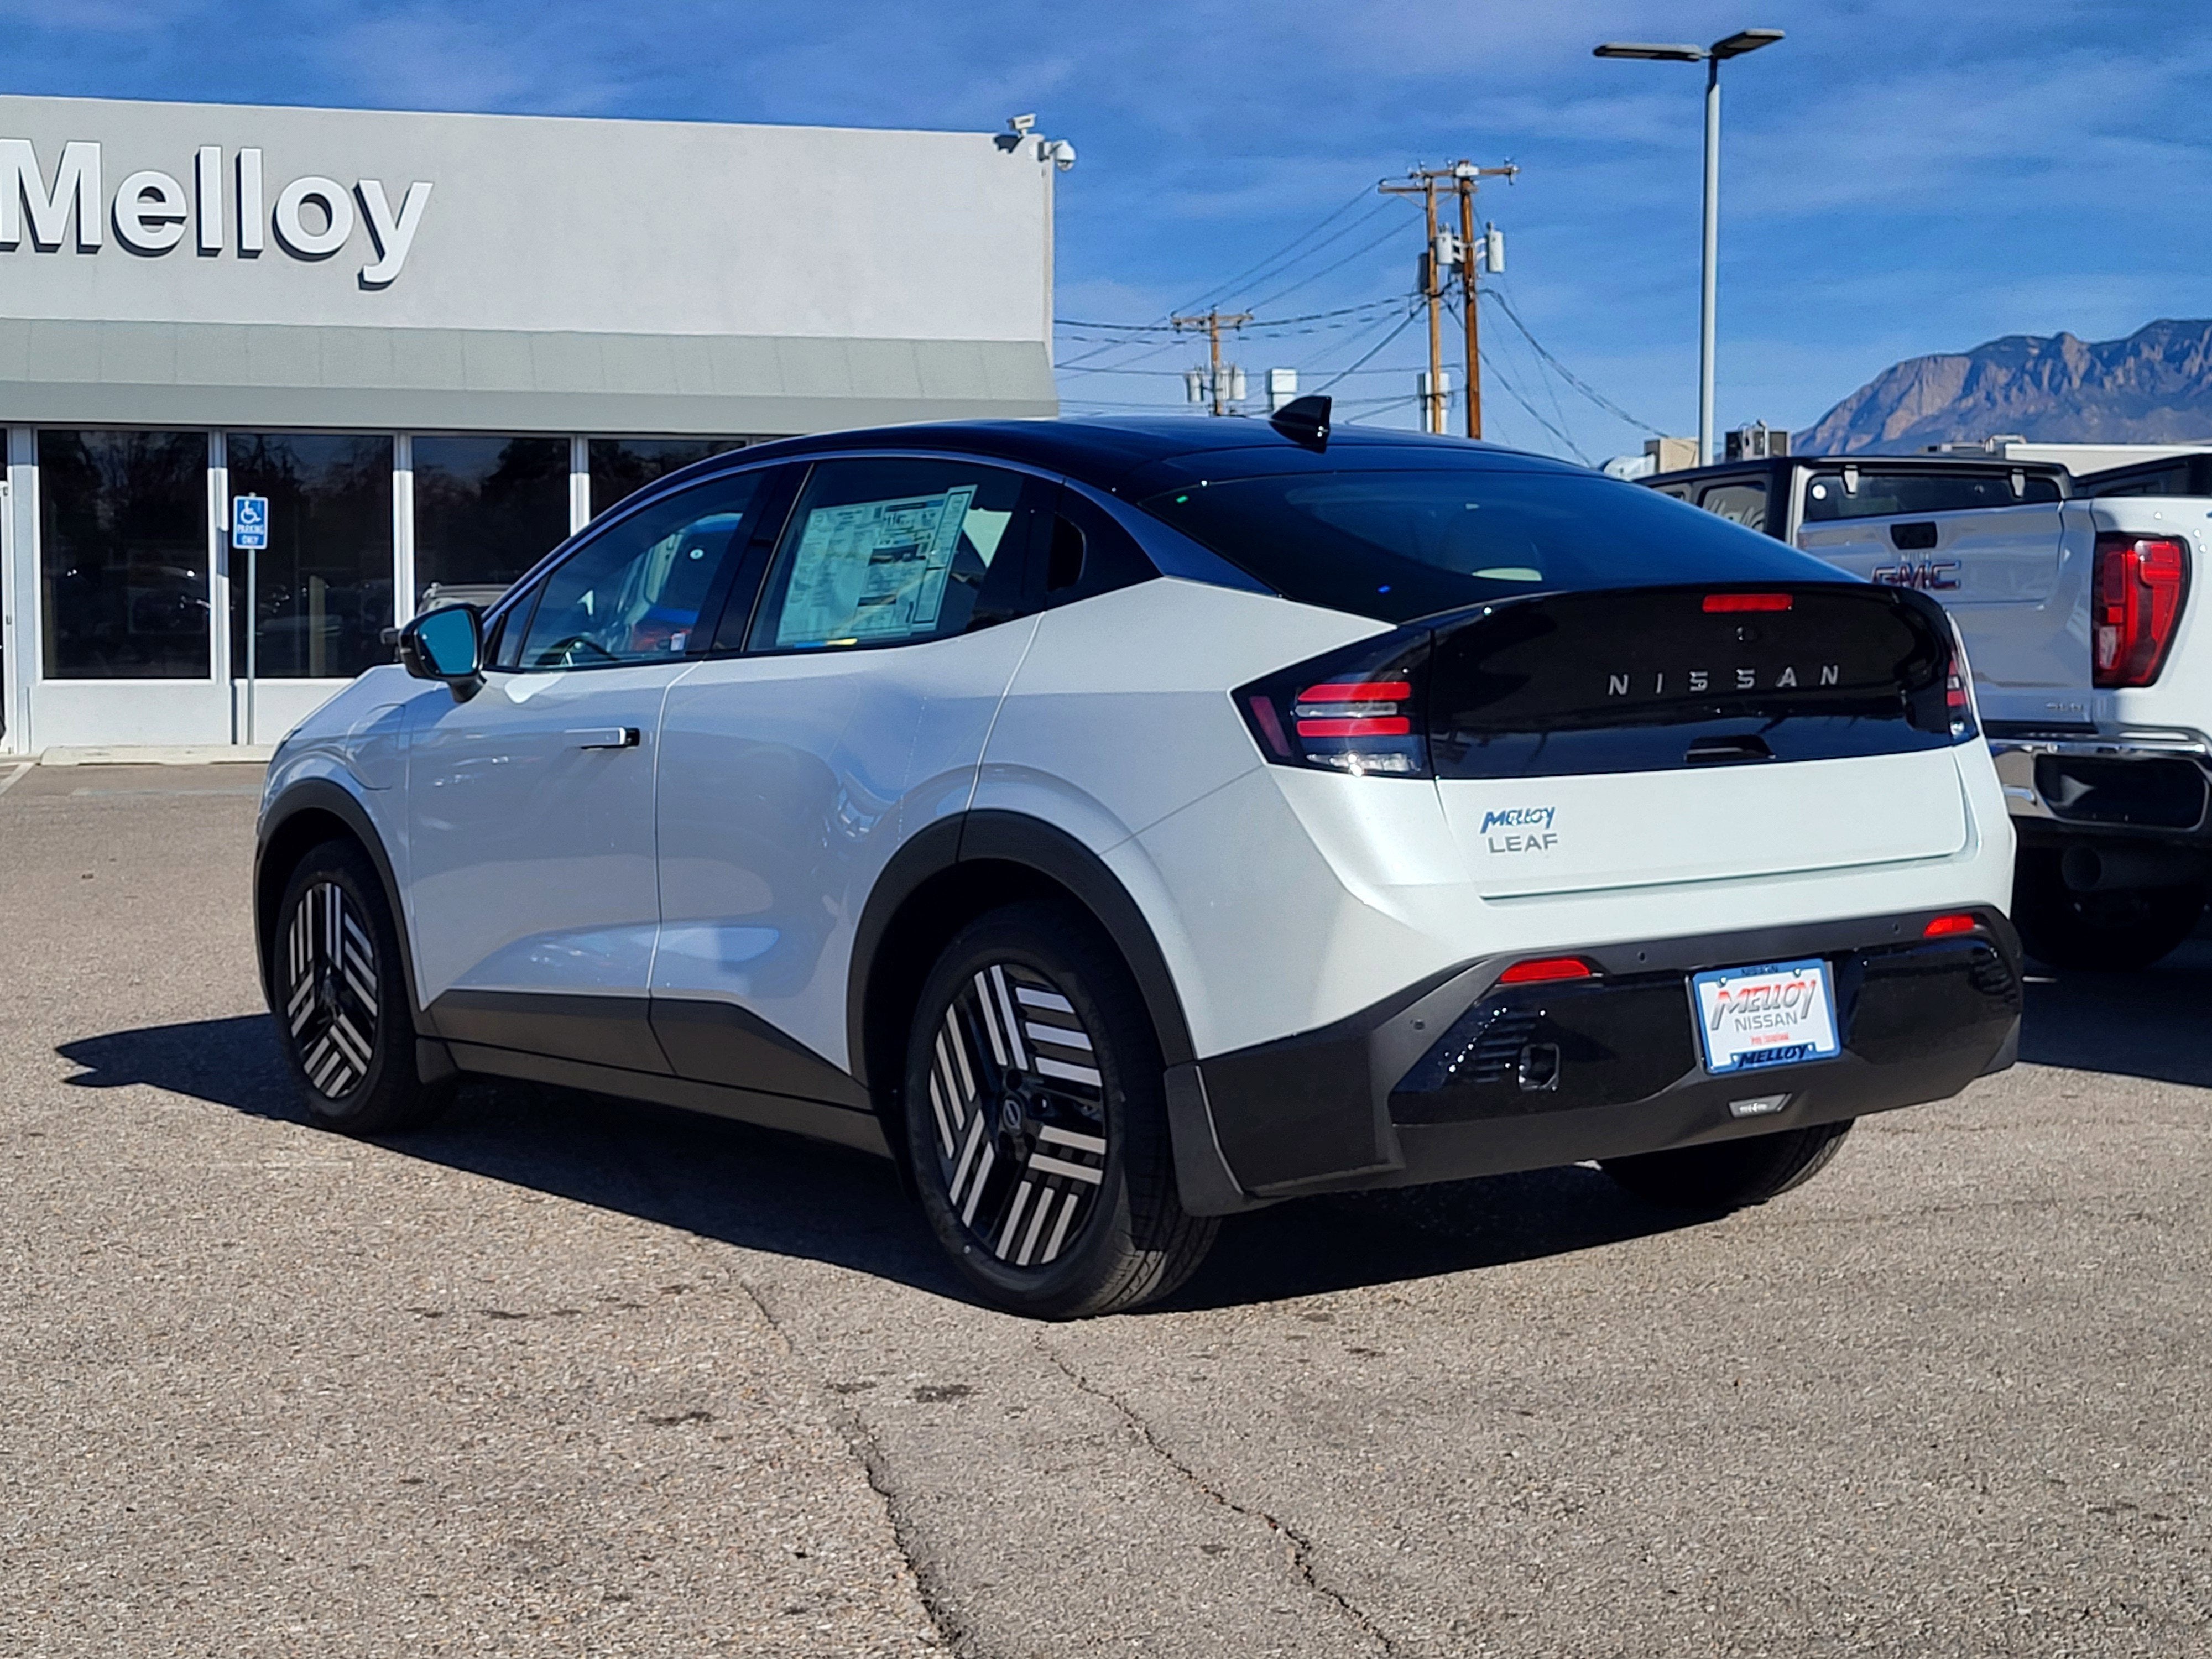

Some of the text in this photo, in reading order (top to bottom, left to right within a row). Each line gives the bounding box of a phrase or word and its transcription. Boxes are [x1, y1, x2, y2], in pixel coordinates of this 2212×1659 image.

[0, 138, 434, 290] Melloy
[1871, 560, 1962, 591] GMC
[1608, 665, 1839, 696] NISSAN
[1488, 833, 1558, 853] LEAF
[1734, 1011, 1798, 1032] NISSAN
[1738, 1043, 1808, 1067] MELLOY
